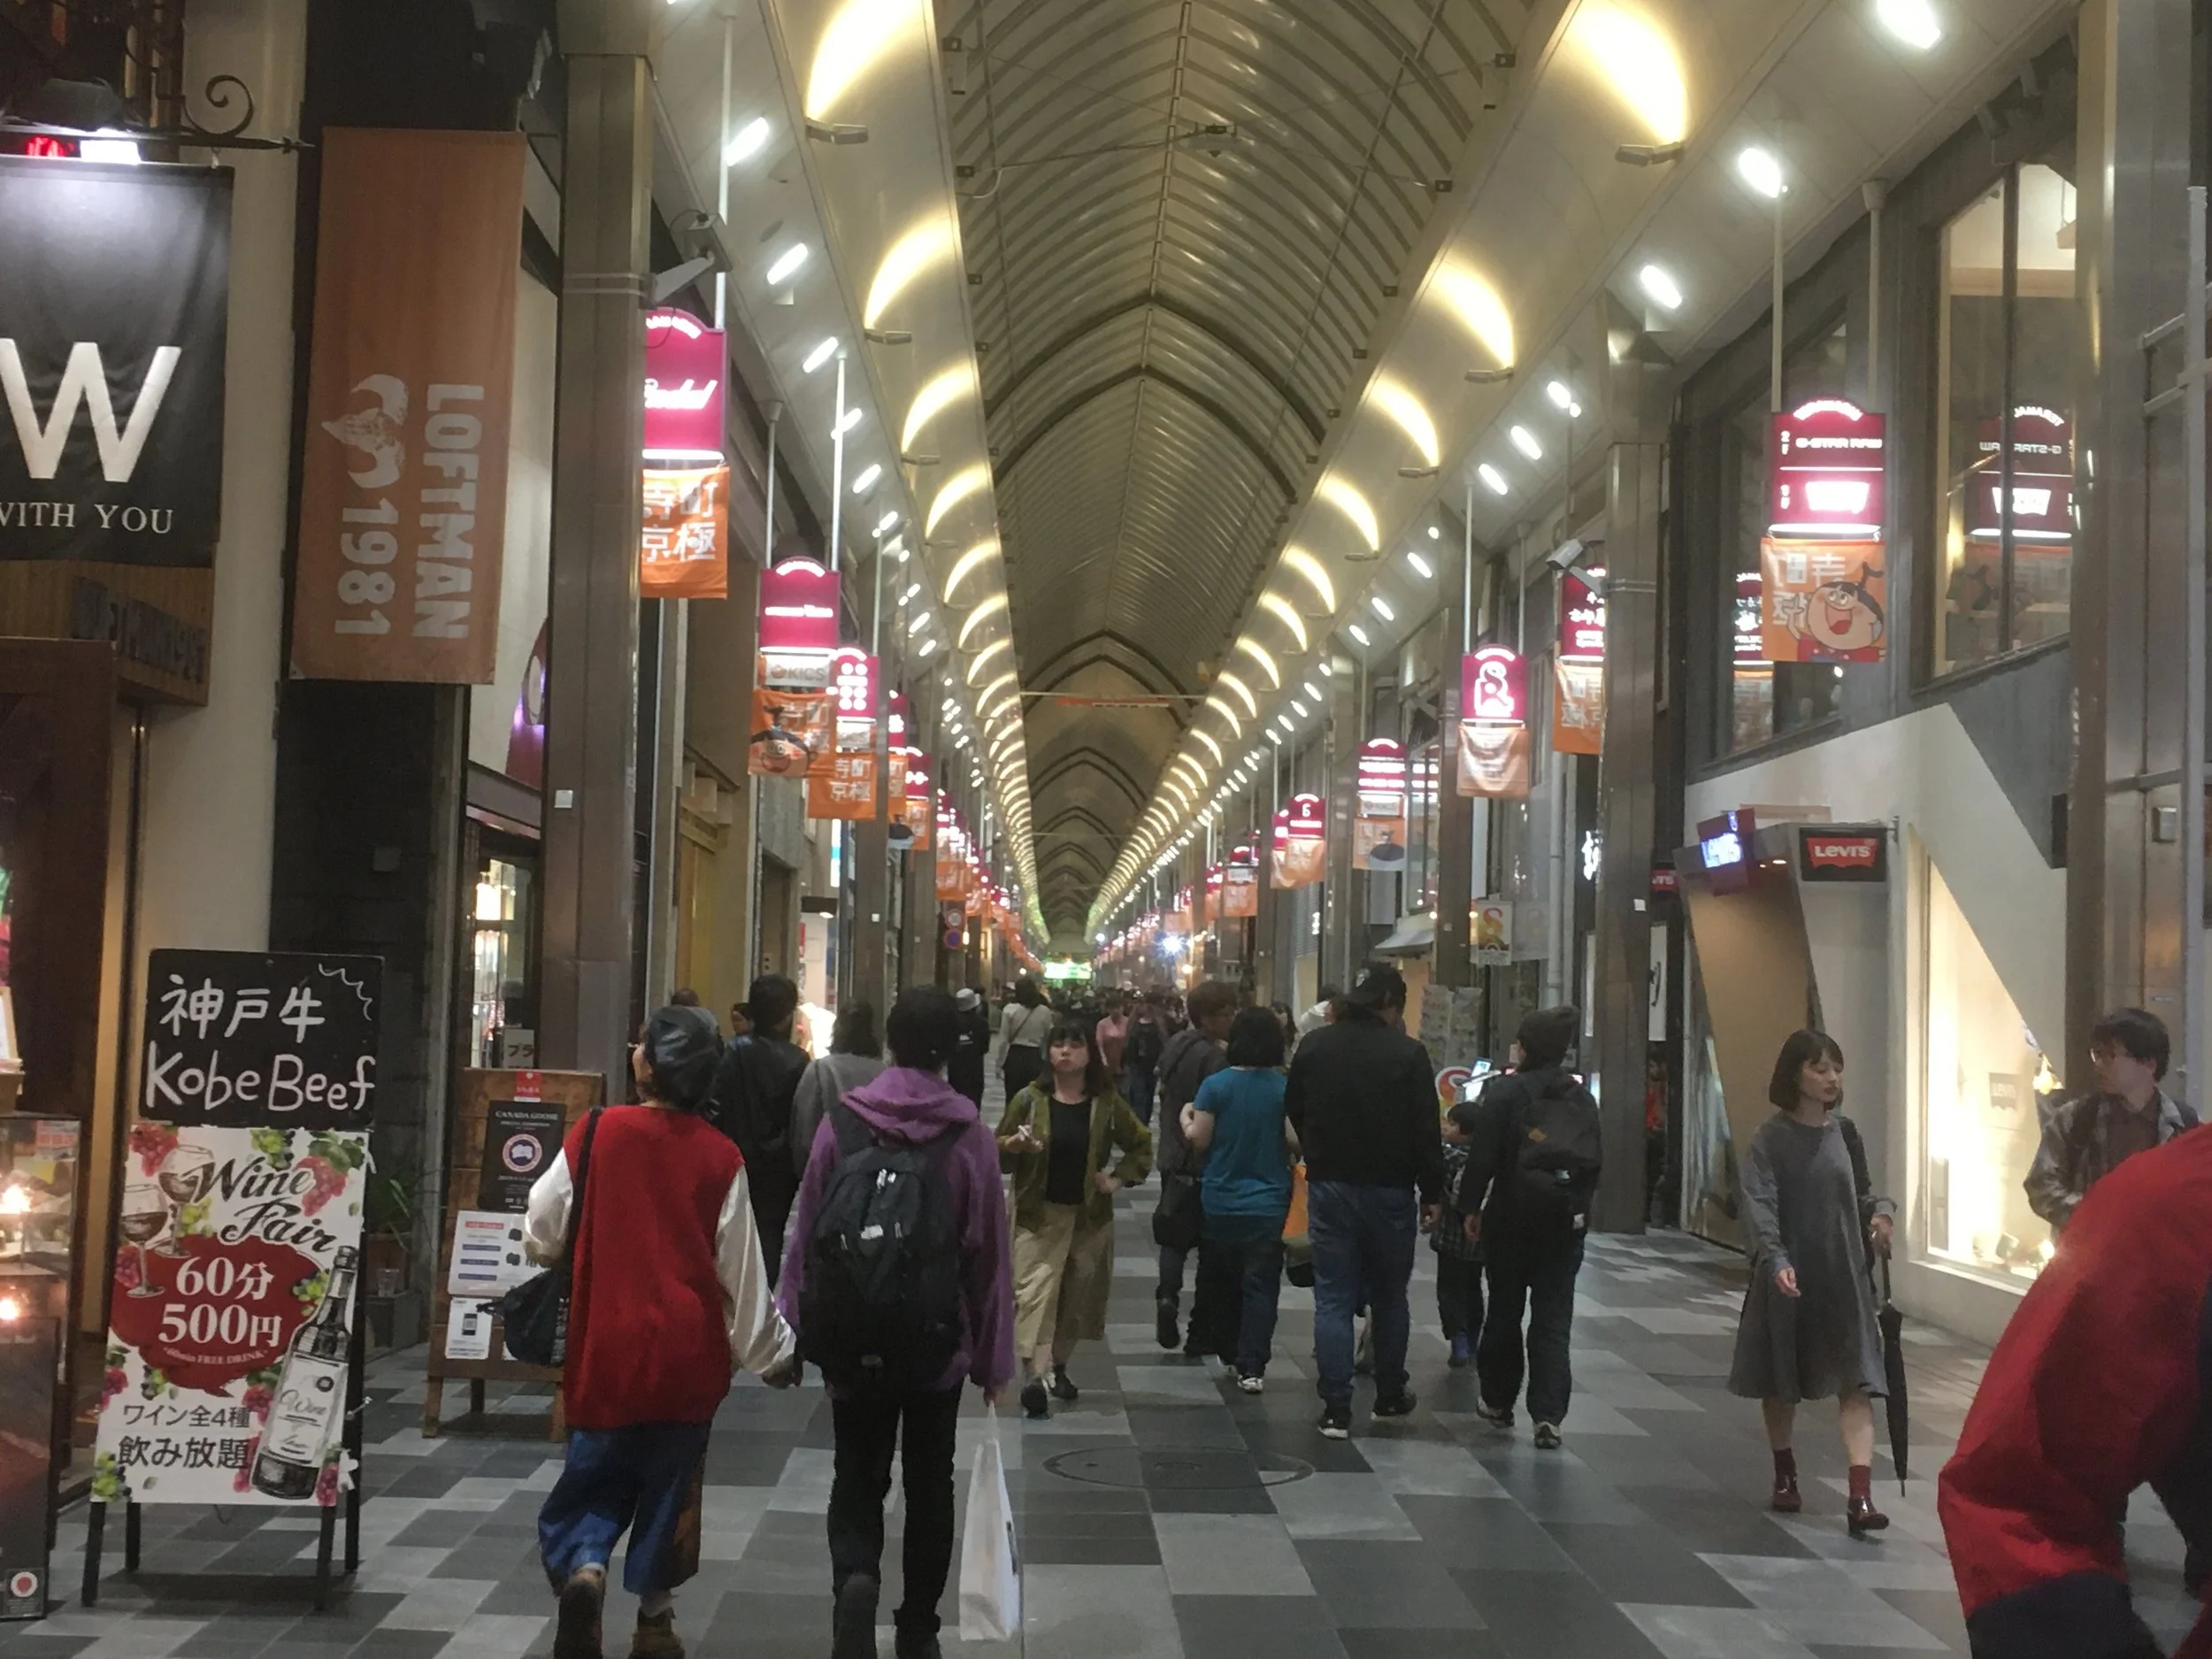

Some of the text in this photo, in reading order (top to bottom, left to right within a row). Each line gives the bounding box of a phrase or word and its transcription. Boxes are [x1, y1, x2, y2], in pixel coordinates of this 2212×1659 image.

[94, 504, 173, 534] YOU
[412, 384, 485, 639] LOFTMAN
[334, 498, 399, 634] 1981
[159, 974, 326, 1044] 神戸牛
[145, 1041, 376, 1111] Kobe Beef
[495, 1110, 530, 1119] CANADA
[182, 1156, 313, 1203] Wine
[220, 1196, 337, 1253] Fair
[176, 1256, 275, 1301] 60分
[157, 1302, 282, 1348] 500円
[122, 1404, 250, 1428] ワイン全4種
[118, 1435, 251, 1470] 飲み放題
